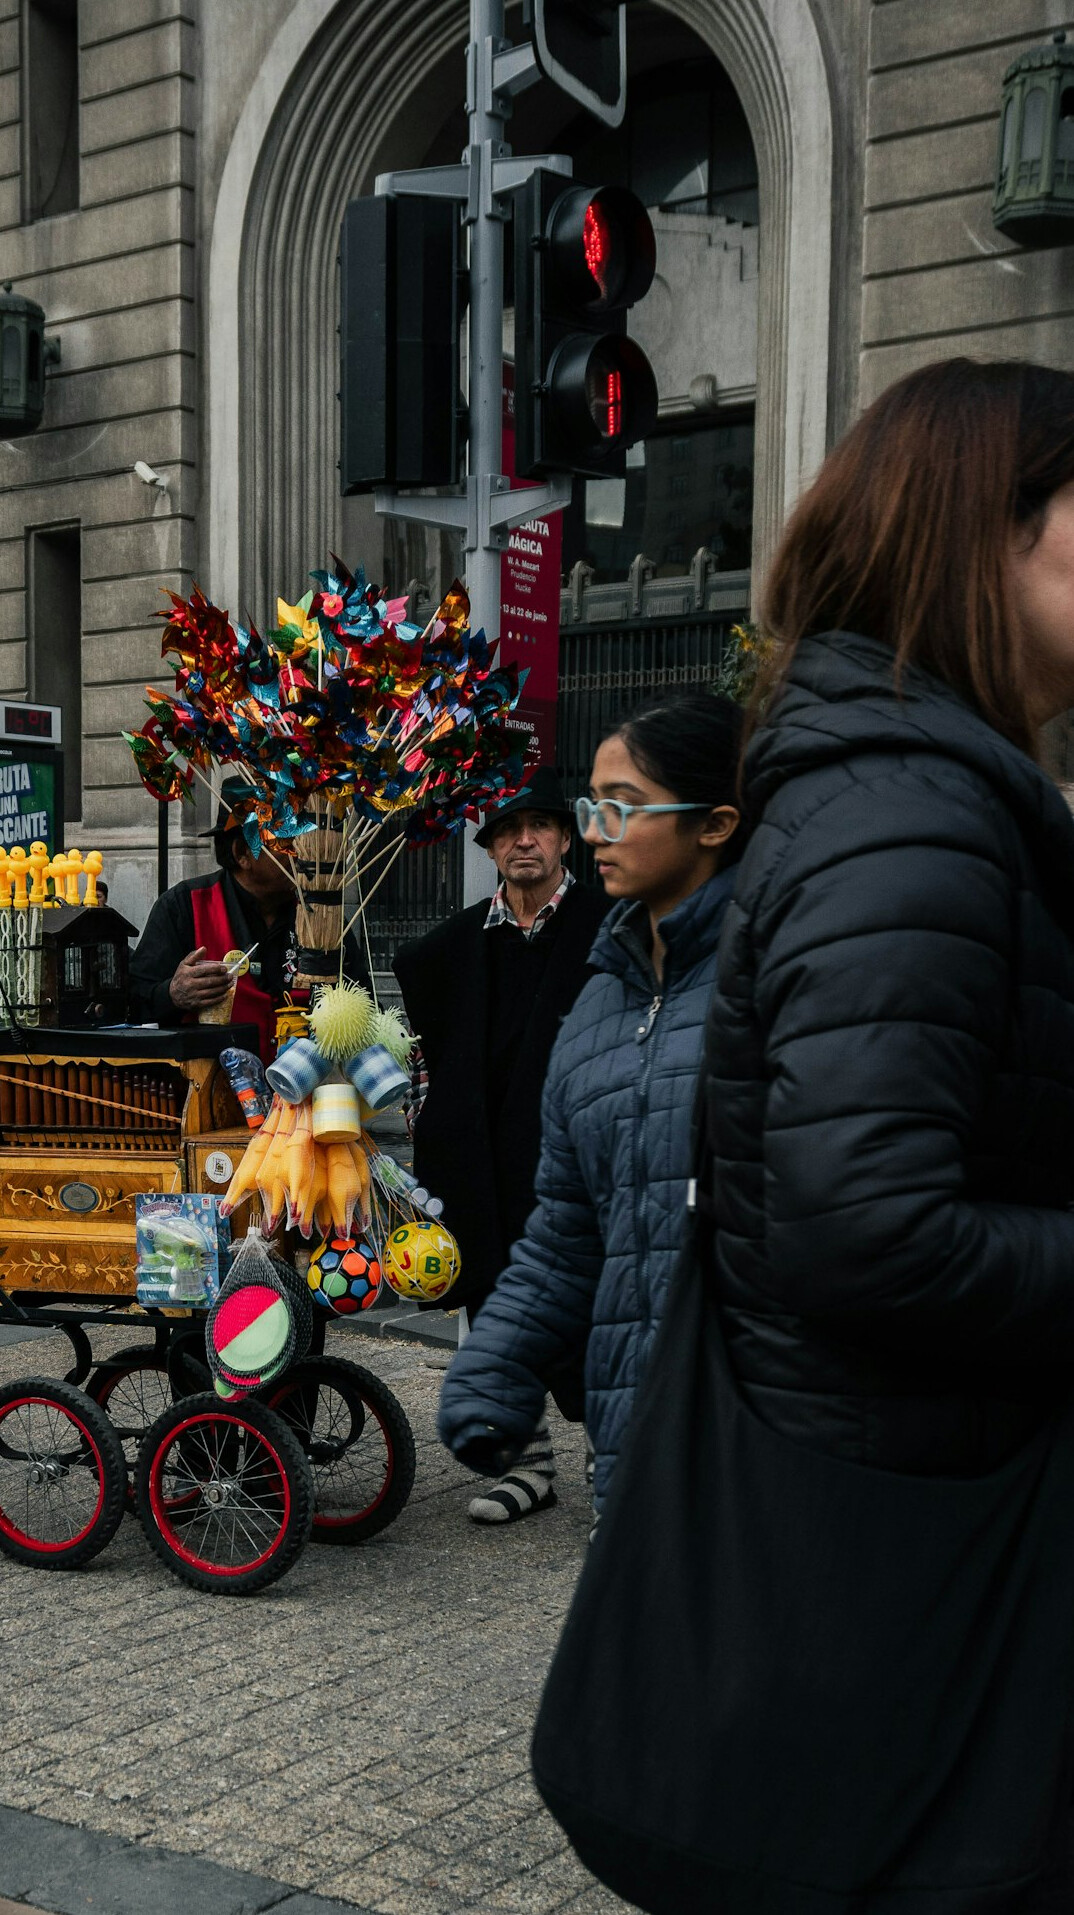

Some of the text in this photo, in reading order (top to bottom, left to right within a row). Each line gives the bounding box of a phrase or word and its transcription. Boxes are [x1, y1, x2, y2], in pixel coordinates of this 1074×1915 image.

[507, 556, 540, 572] W. A. Mozart
[510, 568, 537, 583] Prudencio
[515, 582, 532, 594] Hucke
[502, 603, 548, 622] 13 al 22 de junio
[504, 718, 535, 732] ENTRADAS
[425, 1255, 441, 1274] B
